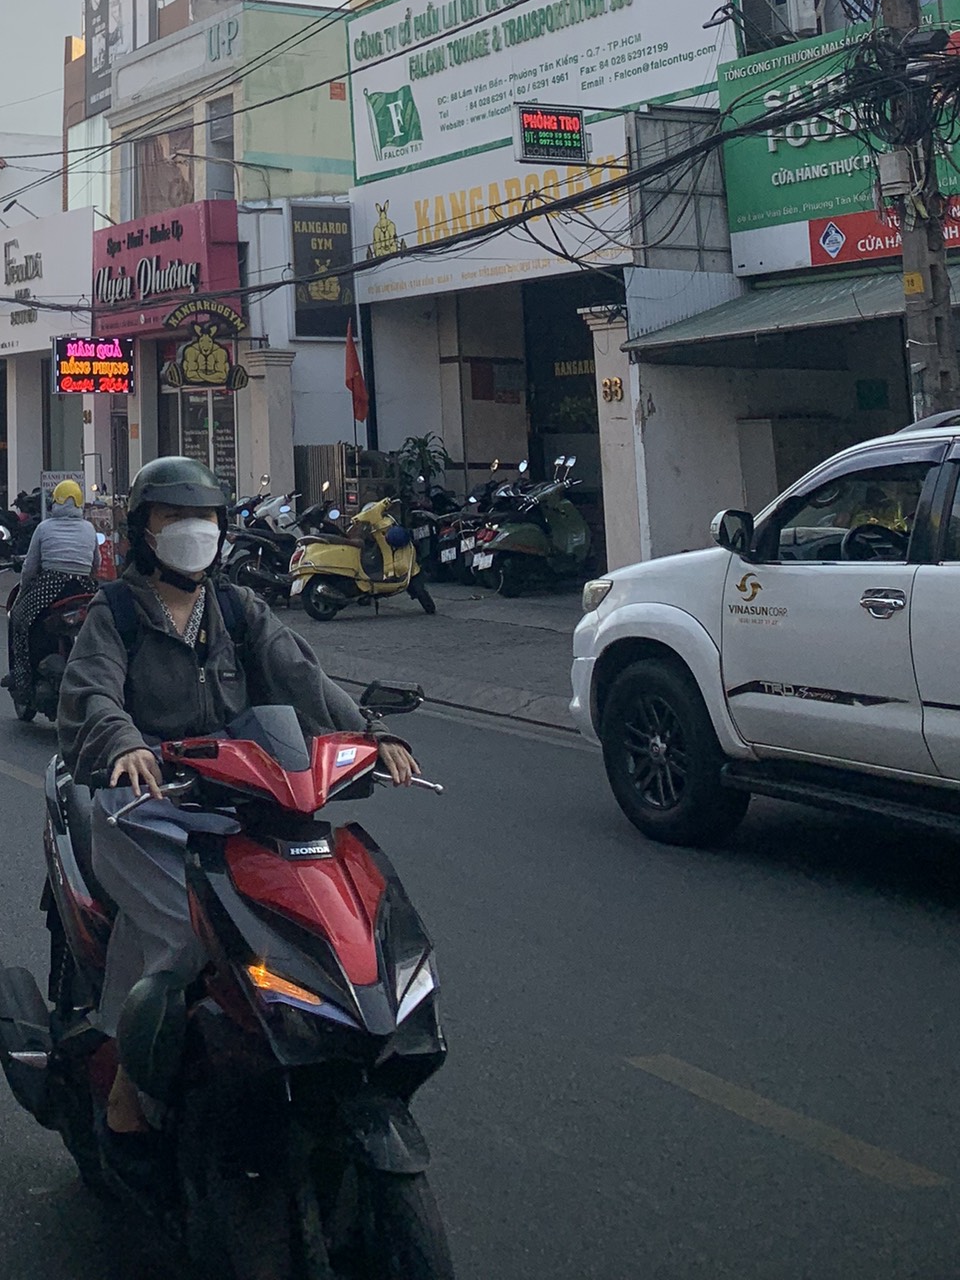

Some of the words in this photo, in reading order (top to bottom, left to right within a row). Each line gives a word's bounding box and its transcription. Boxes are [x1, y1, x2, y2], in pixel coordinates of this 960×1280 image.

[607, 33, 642, 52] TP.HCM
[408, 44, 448, 82] FALCON
[447, 30, 491, 67] TOWAGE
[614, 44, 717, 81] Falcon@falcontug.com
[523, 110, 557, 129] PHÒNG
[559, 116, 579, 132] TRỌ
[293, 220, 348, 234] KANGAROO
[310, 237, 333, 250] GYM
[857, 234, 884, 252] CỬA
[760, 681, 795, 697] TRD
[290, 846, 331, 855] HONDA
